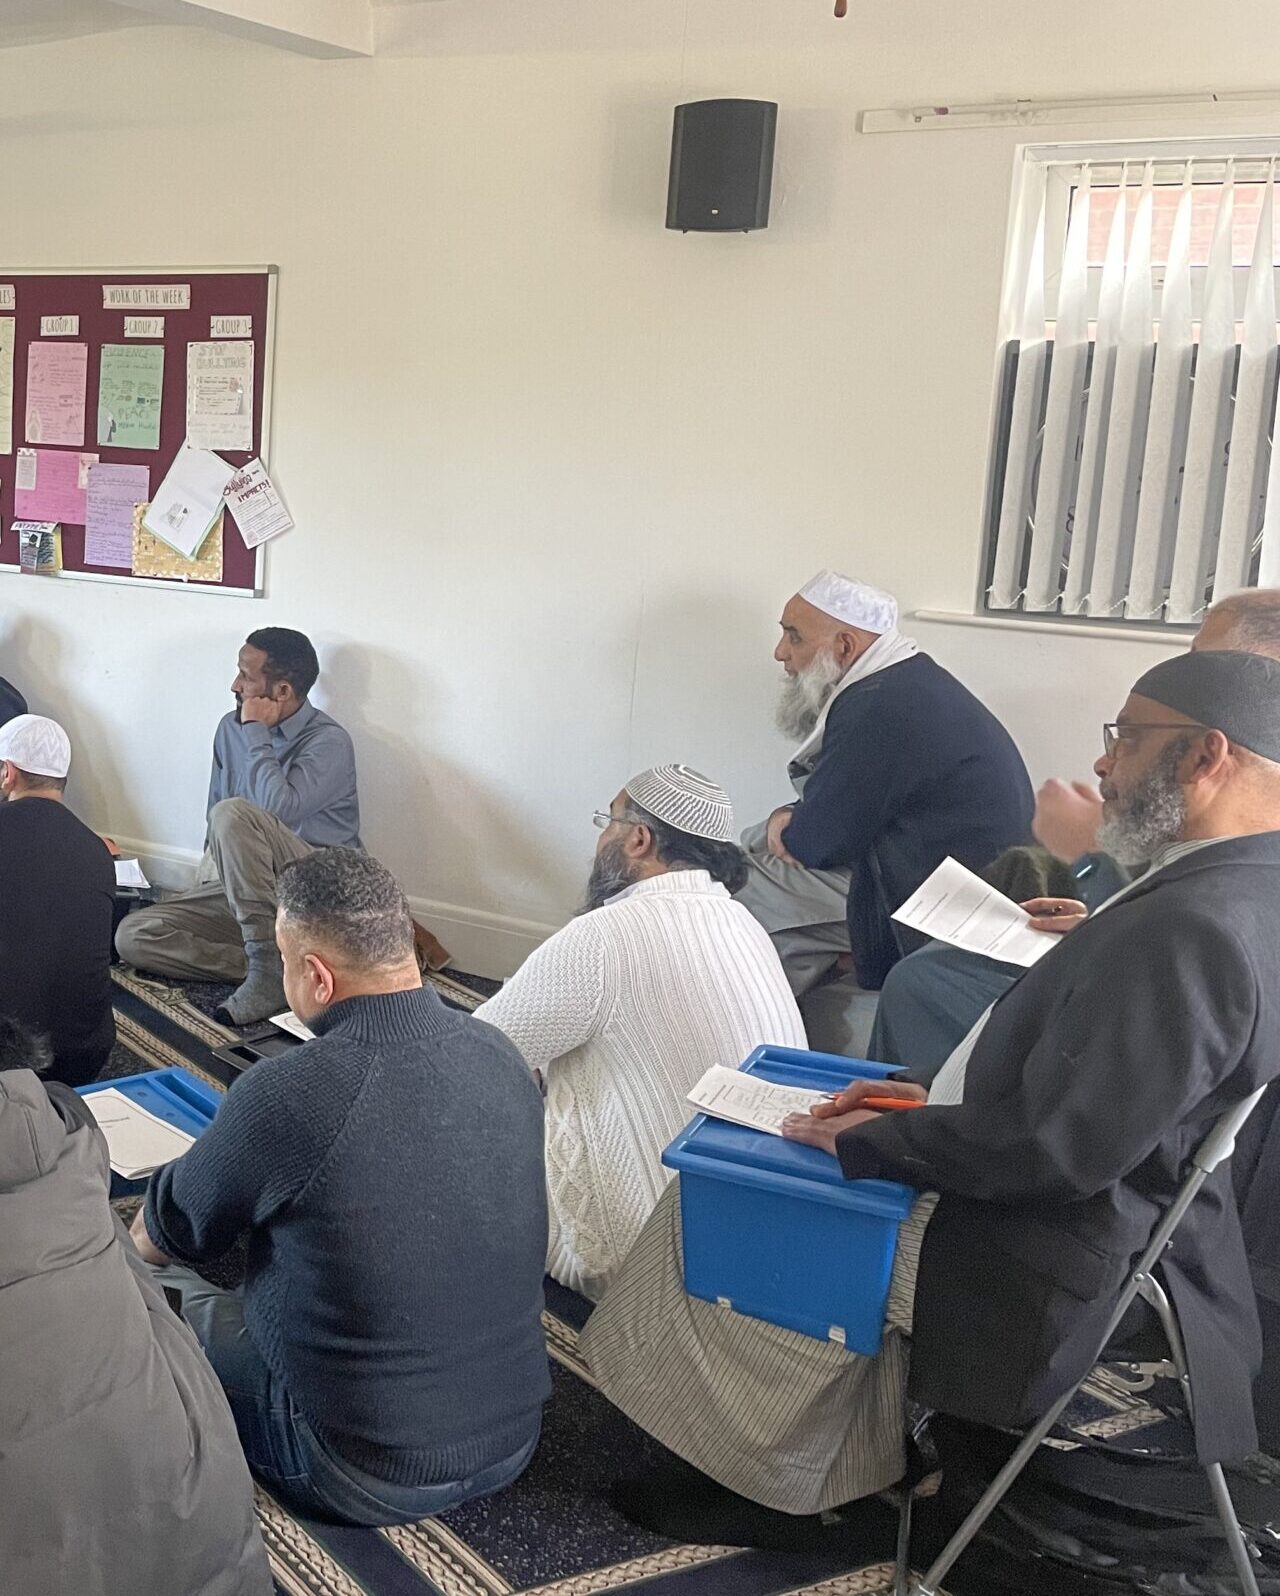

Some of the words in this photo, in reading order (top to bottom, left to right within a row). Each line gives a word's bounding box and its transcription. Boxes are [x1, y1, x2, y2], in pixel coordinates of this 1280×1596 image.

[110, 289, 130, 303] WORK
[132, 289, 142, 303] OF
[145, 289, 159, 303] THE
[162, 289, 184, 304] WEEK
[46, 319, 68, 332] GROUP
[130, 320, 150, 334] GROUP
[215, 319, 240, 334] GROUP
